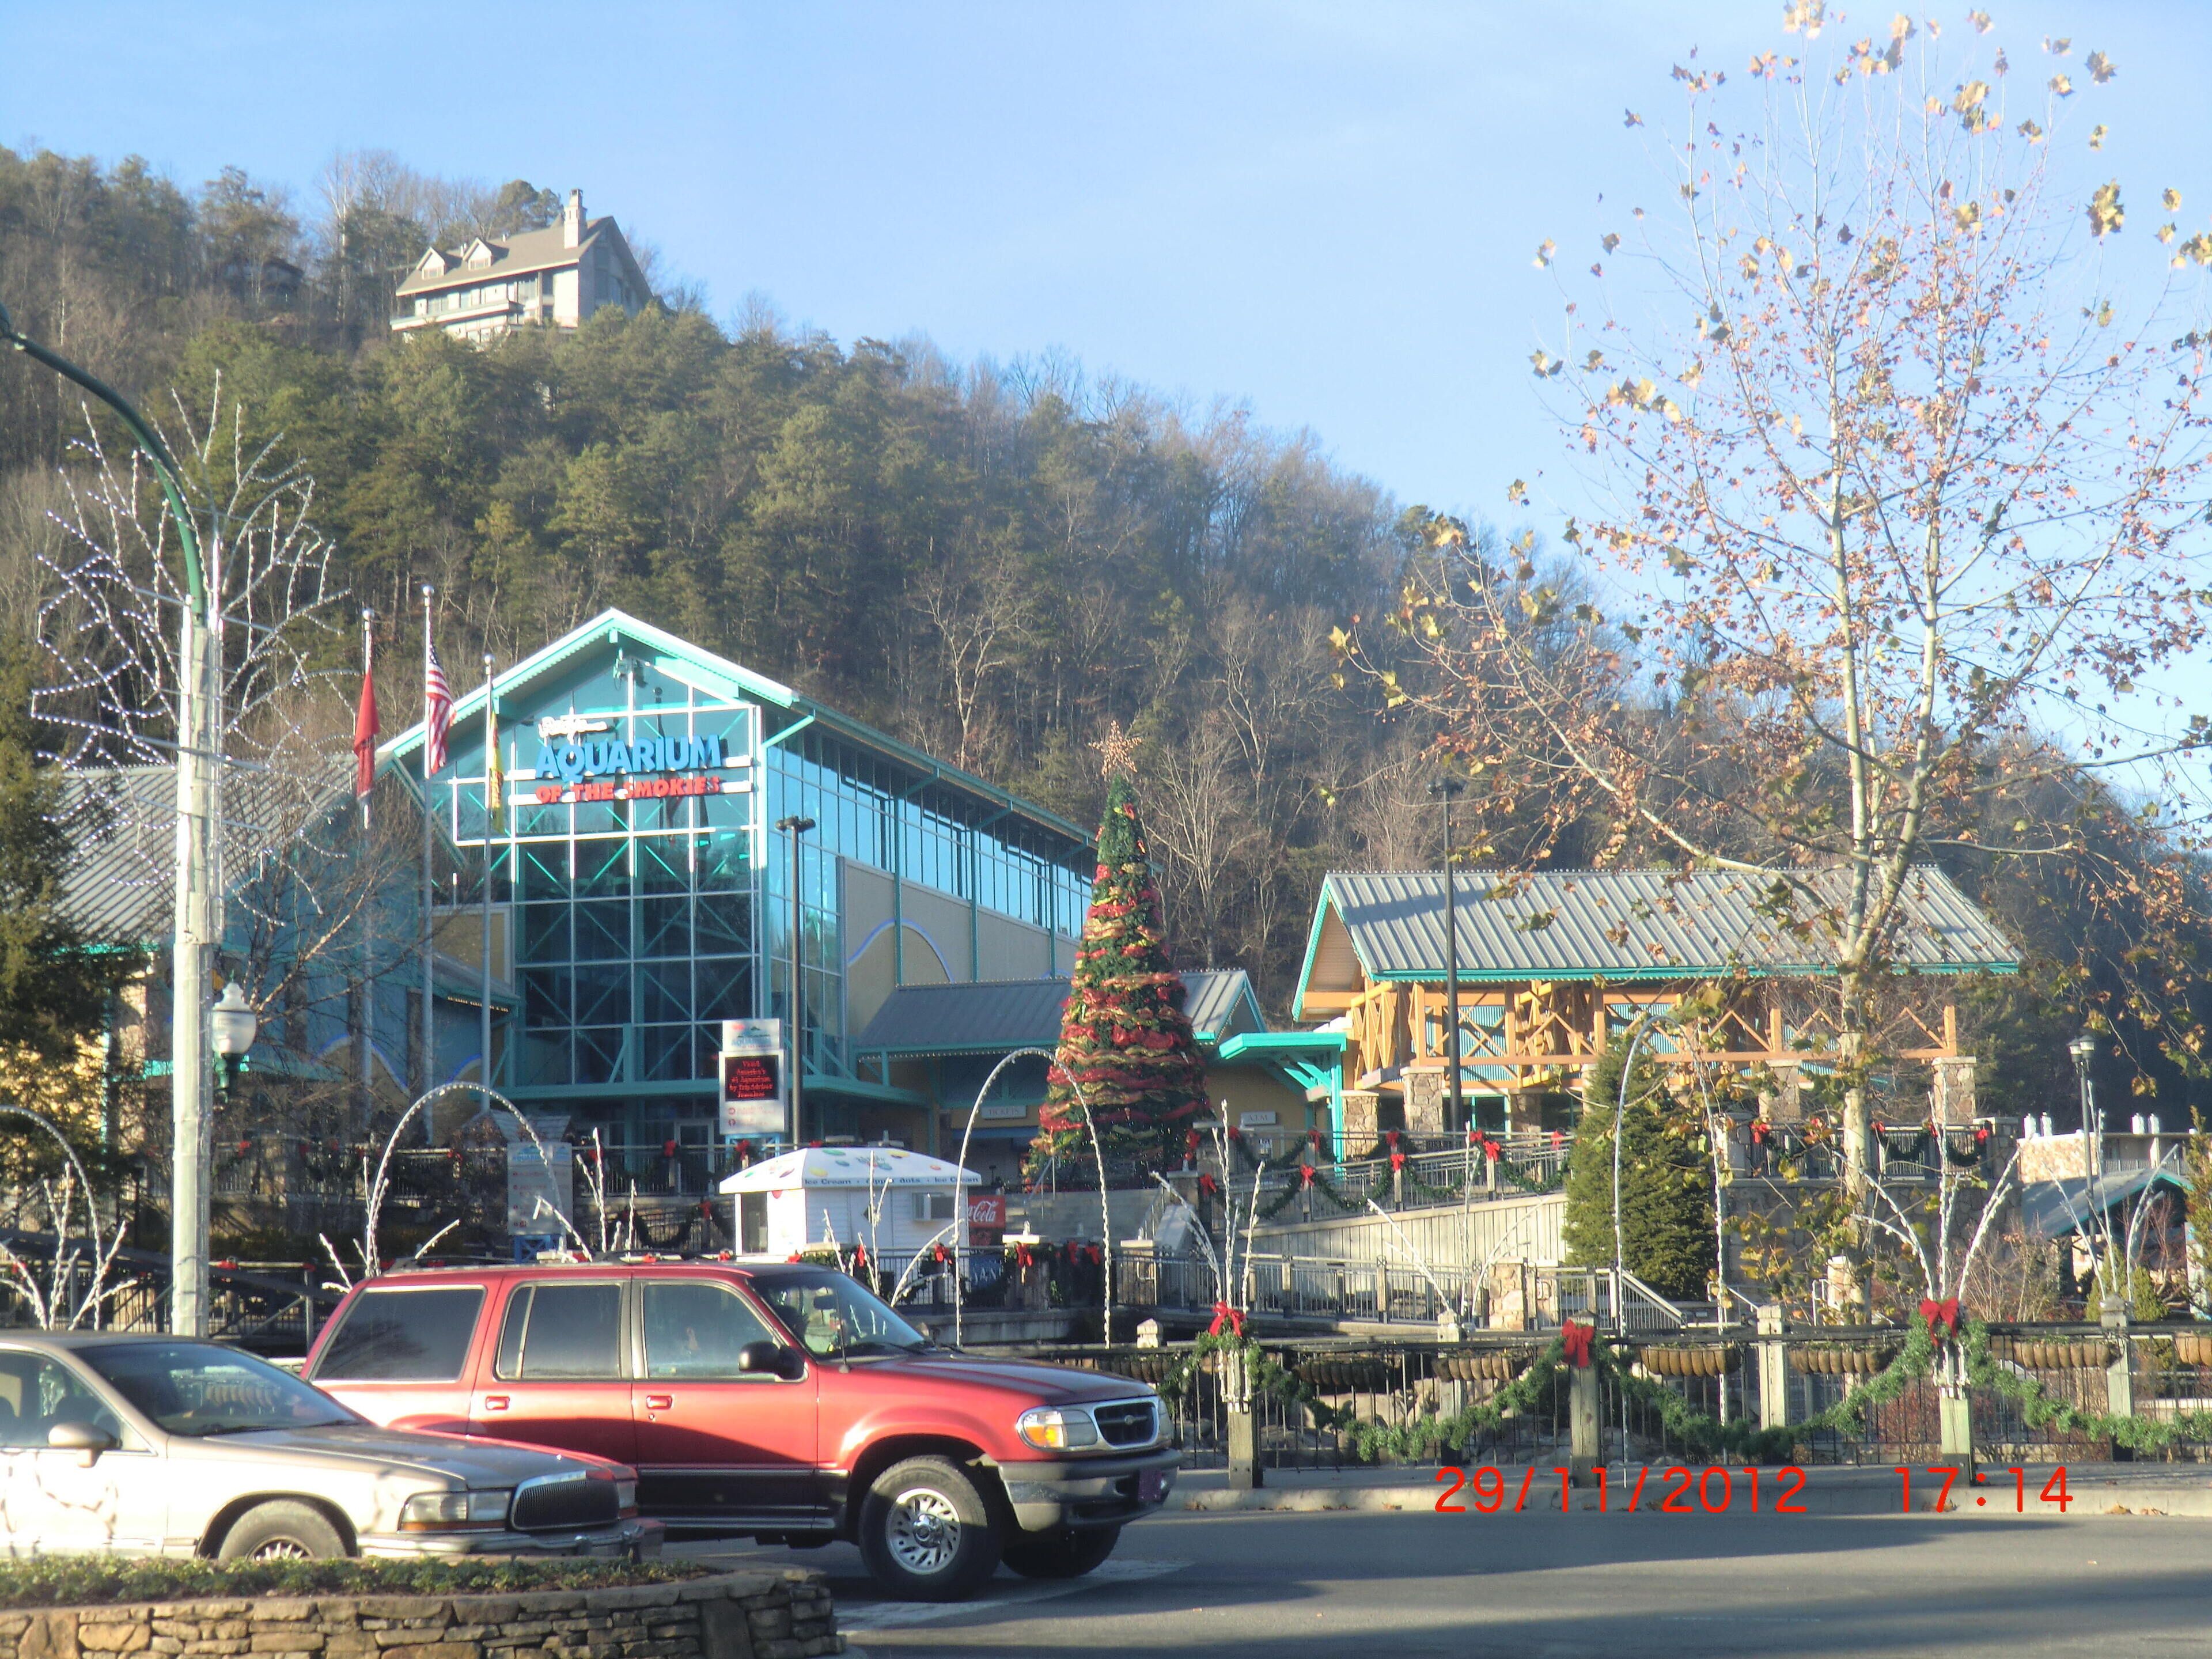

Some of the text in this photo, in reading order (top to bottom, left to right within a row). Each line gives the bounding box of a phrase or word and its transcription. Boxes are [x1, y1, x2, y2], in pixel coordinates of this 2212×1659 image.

[535, 734, 721, 783] AQUARIUM
[535, 776, 720, 804] OF THE SMOKIES
